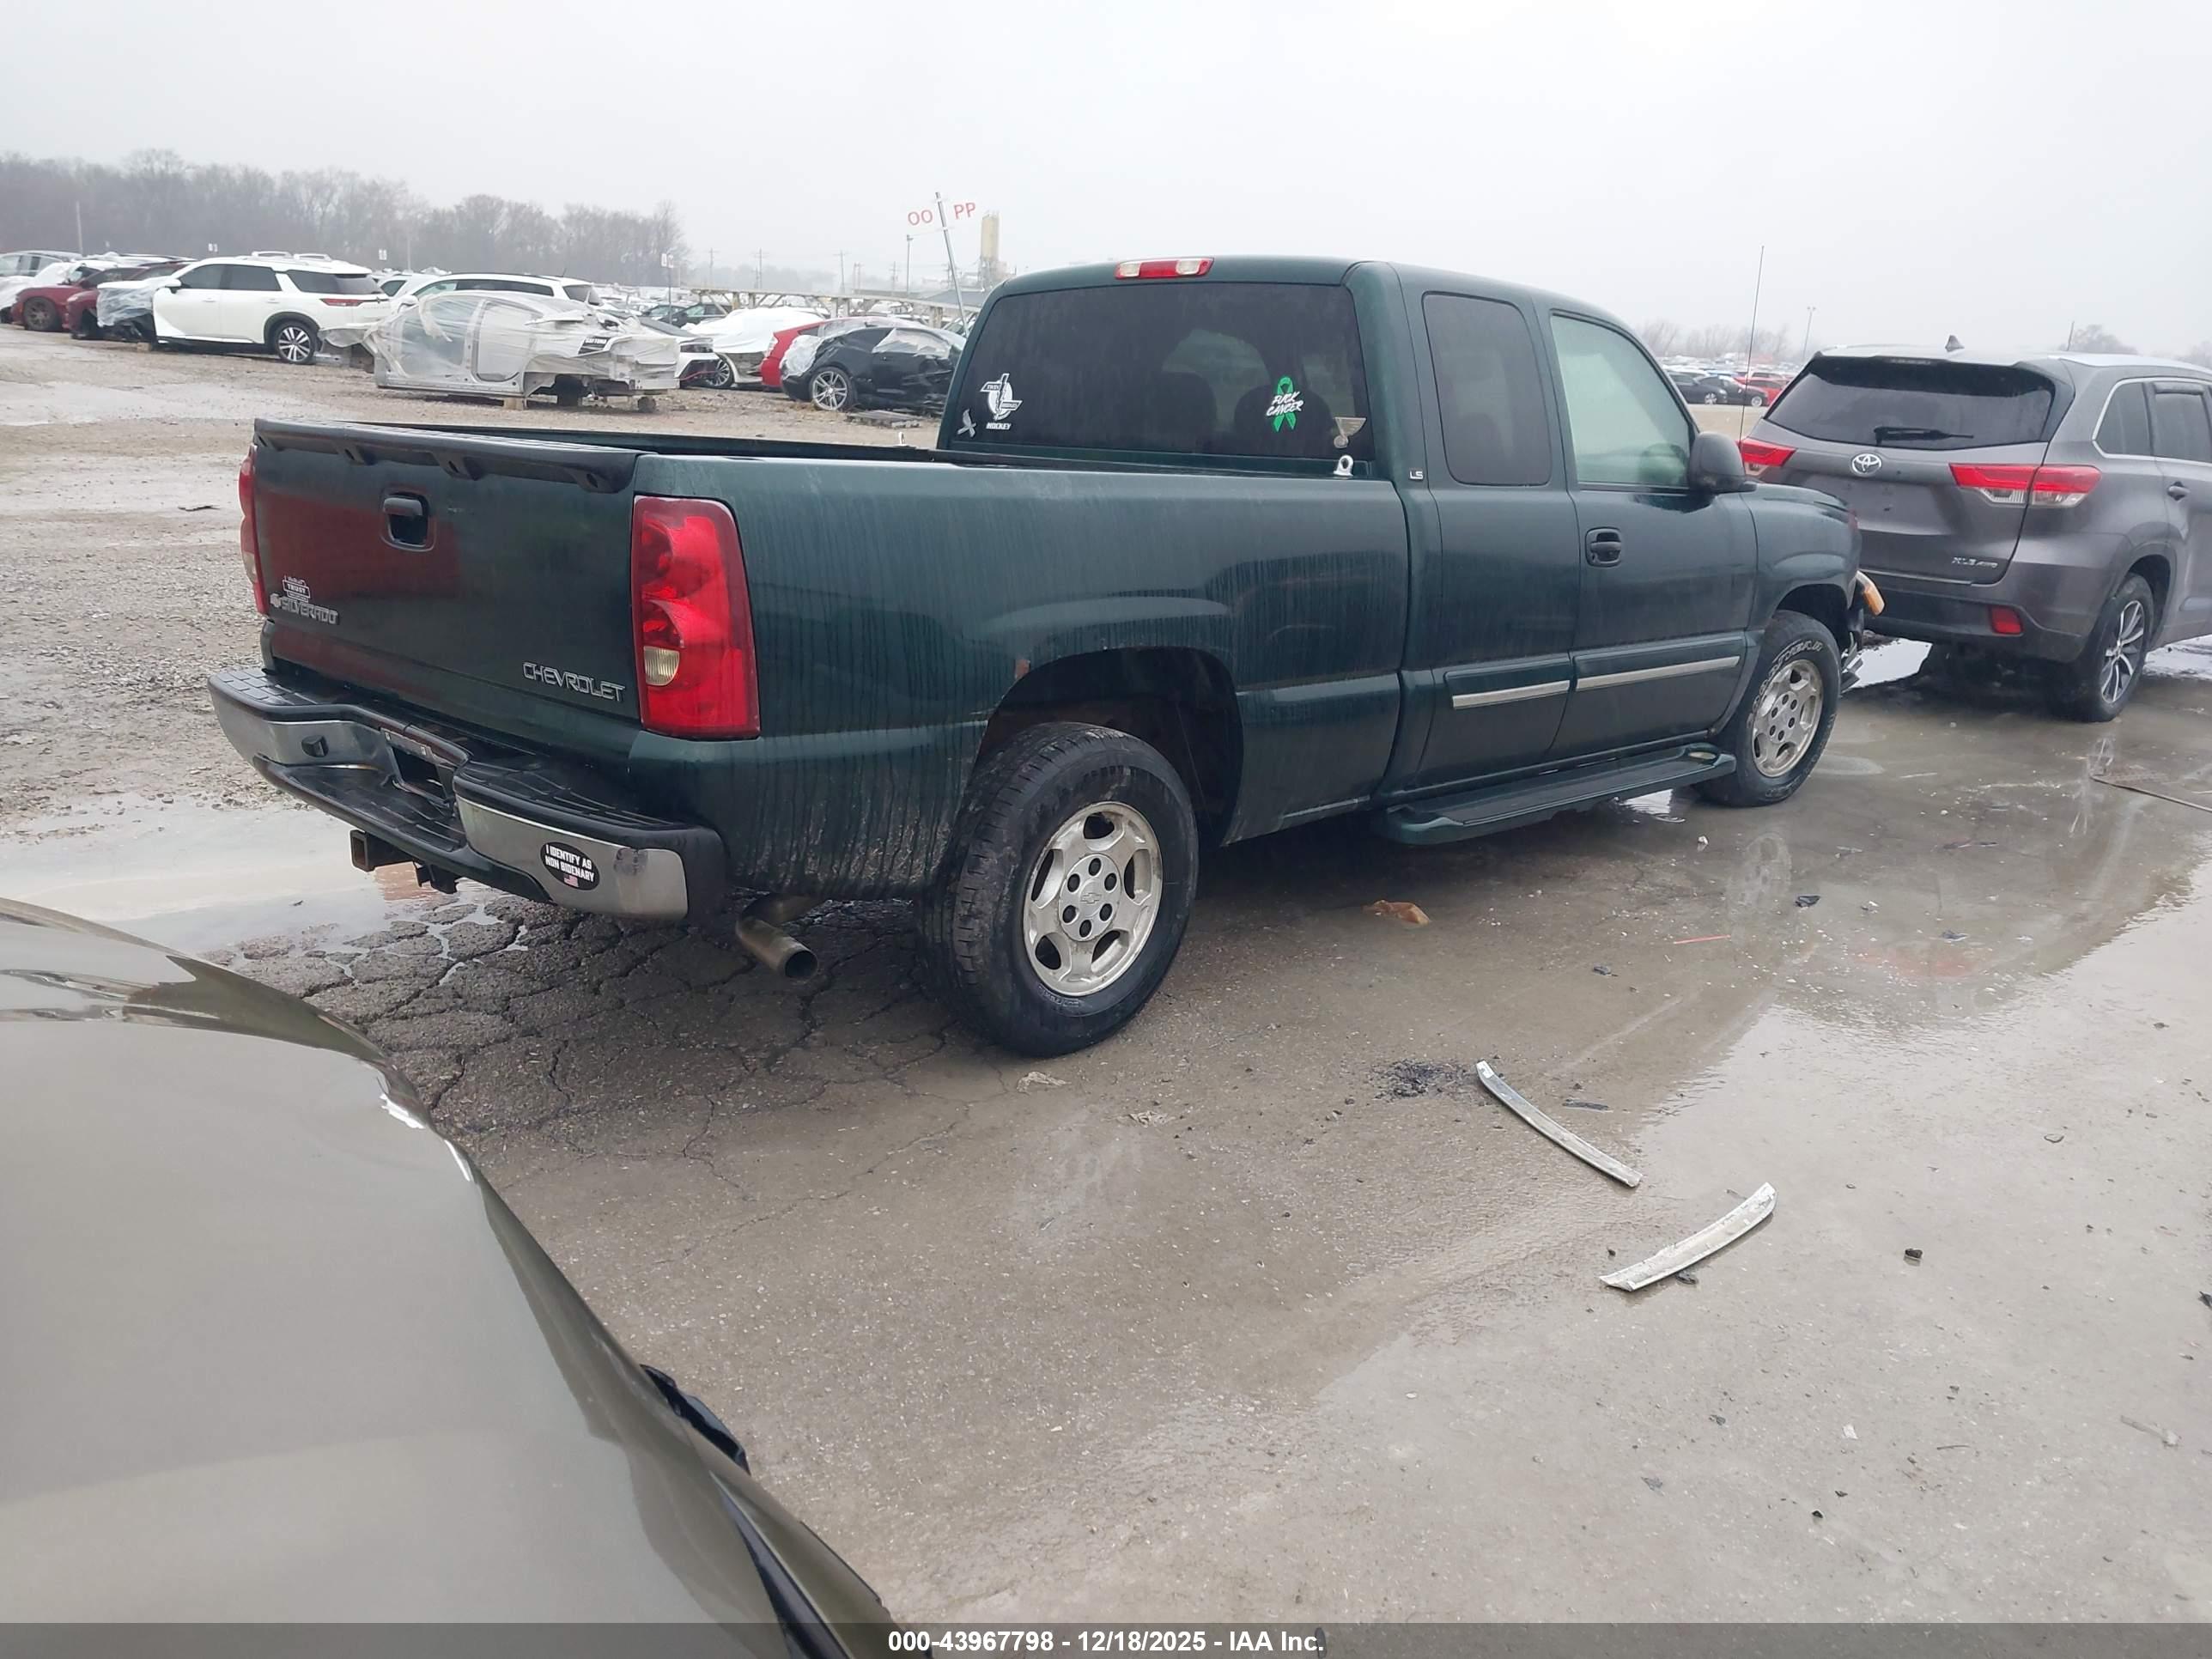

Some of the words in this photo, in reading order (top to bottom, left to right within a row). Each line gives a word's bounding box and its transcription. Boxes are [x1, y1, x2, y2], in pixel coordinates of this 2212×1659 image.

[953, 202, 976, 220] PP
[1271, 391, 1300, 405] FUCK
[1266, 400, 1304, 416] CANCER
[1409, 470, 1424, 480] LS
[287, 583, 307, 593] TRUST
[281, 596, 338, 624] SILVERADO
[523, 661, 626, 702] CHEVROLET
[550, 846, 580, 866] IDENTIFY
[582, 858, 592, 870] AS
[544, 855, 560, 869] NON
[560, 861, 594, 882] BIDENARY
